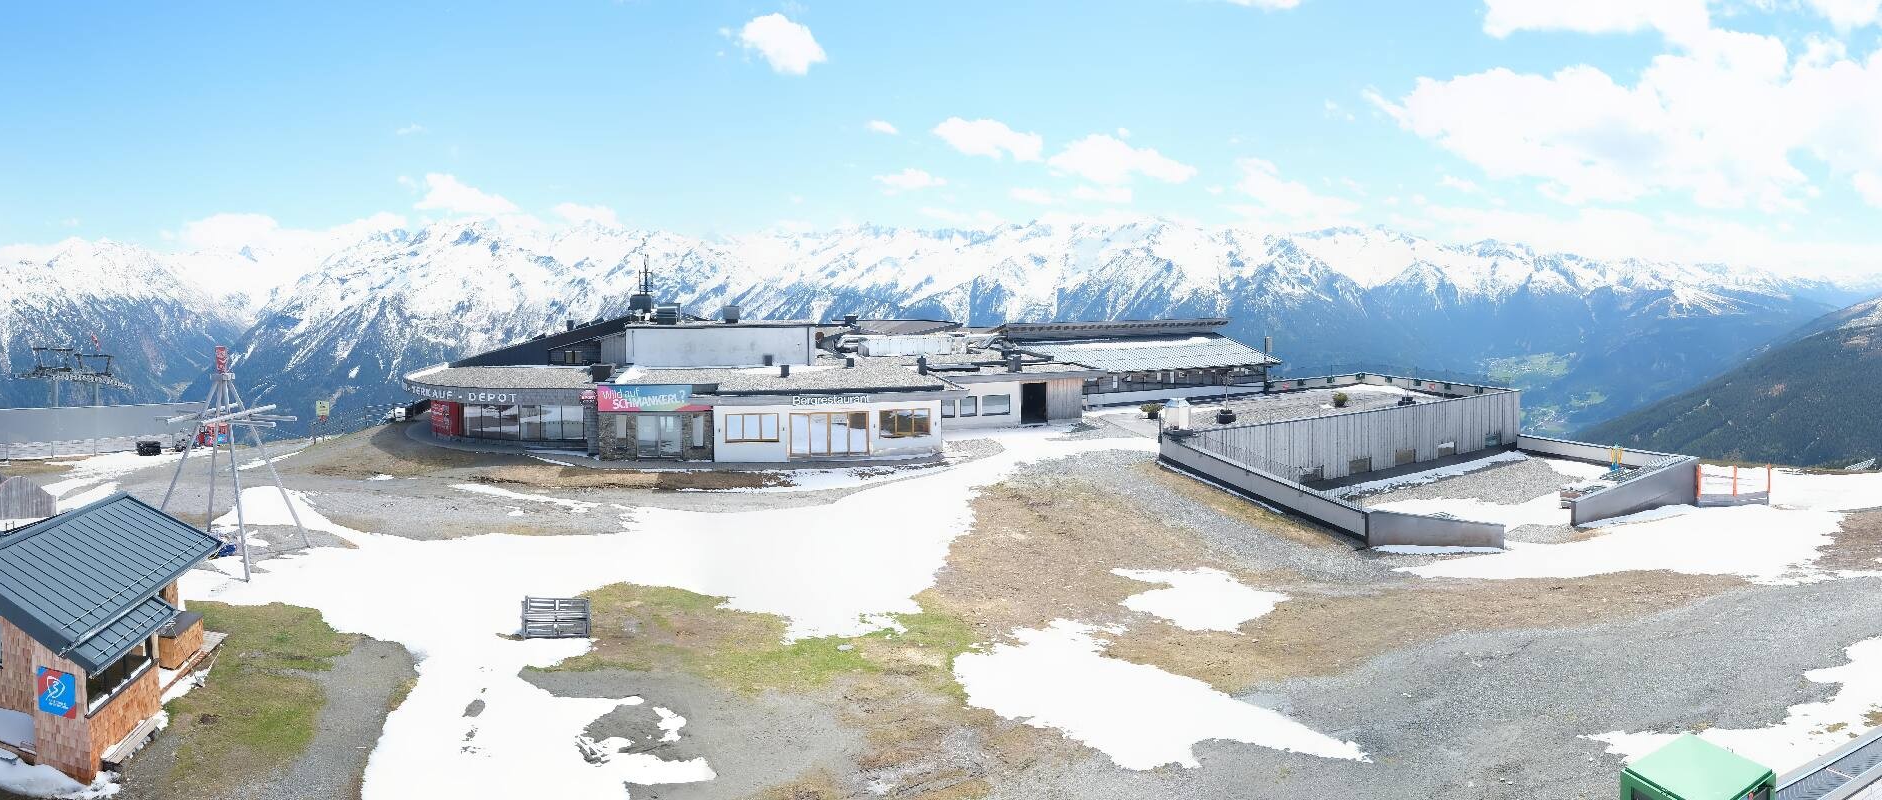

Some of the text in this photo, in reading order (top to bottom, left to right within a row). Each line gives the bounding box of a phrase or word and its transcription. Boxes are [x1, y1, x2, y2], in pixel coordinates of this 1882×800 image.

[468, 392, 517, 402] DEPOT
[602, 388, 640, 400] Wild auf
[612, 389, 686, 410] SCHMANKERL?
[792, 394, 870, 406] Bergrestaurant
